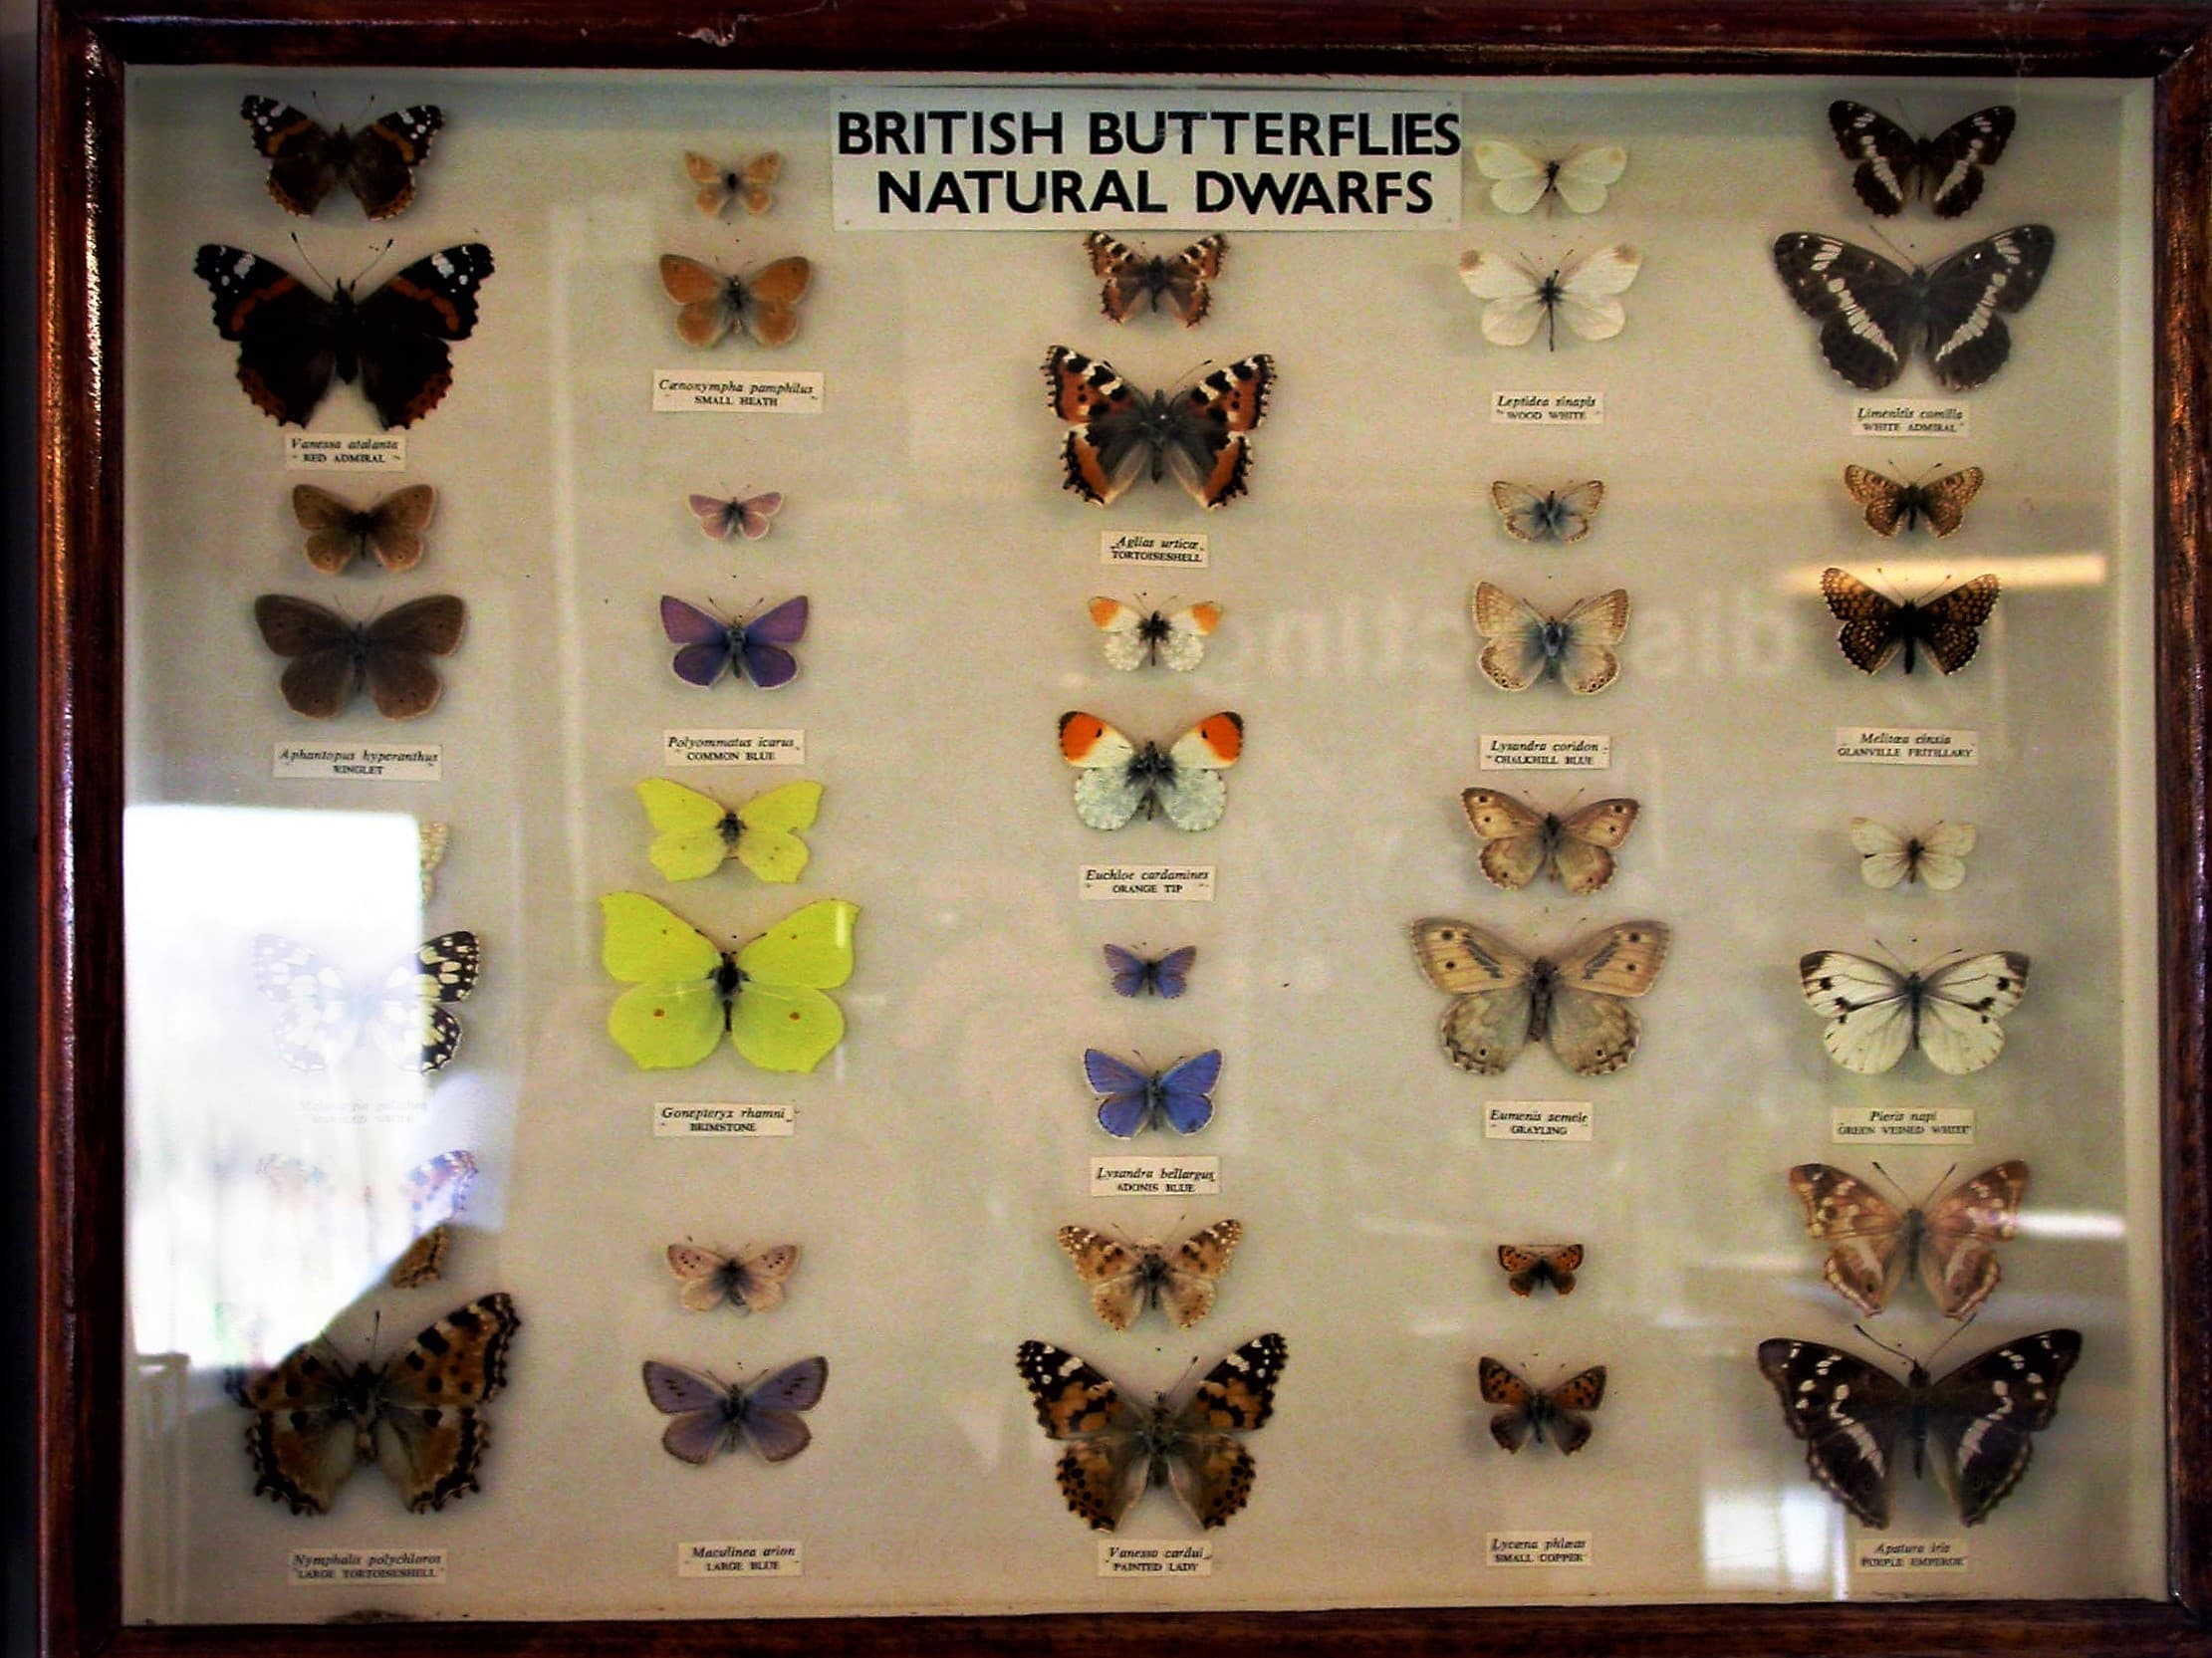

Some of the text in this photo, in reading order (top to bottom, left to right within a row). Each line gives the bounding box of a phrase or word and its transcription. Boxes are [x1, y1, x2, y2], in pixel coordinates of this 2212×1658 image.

[838, 111, 1462, 156] BRITISH BUTTERFLIES
[877, 169, 1434, 215] NATURAL DWARFS
[749, 381, 814, 397] pamphilus
[694, 396, 778, 406] SMALL HEATH
[1497, 395, 1597, 408] Leptidea sinapis
[1550, 411, 1586, 420] WHITE
[1857, 407, 1963, 419] Limenitis camilla
[1908, 423, 1957, 432] ADMIRAL
[291, 438, 398, 450] Vanessa atalanta
[303, 453, 385, 463] RED ADMIRAL
[1112, 550, 1203, 563] TORTOISESHELL
[668, 737, 795, 749] Polyommatus icarus
[1491, 740, 1598, 753] Lysandra coridon
[280, 748, 438, 764] Aphantopus hyperanthus
[687, 752, 775, 761] COMMON BLUE
[1837, 748, 1973, 758] GLANVILLE FRITILLARY
[1494, 755, 1593, 765] CHALKHILL BLUE
[333, 765, 384, 775] RINGLET
[1086, 869, 1209, 881] Euchloe cardamines
[1112, 884, 1183, 893] ORANGE TIP
[661, 1107, 786, 1121] Gonepteryx rhamni
[1490, 1109, 1588, 1123] Eumenis semele
[1869, 1110, 1937, 1123] Pieris napi
[689, 1122, 757, 1132] BRIMSTONE
[1511, 1125, 1568, 1135] GRAYLING
[1838, 1125, 1971, 1134] GREEN VEINED WHITE
[1097, 1167, 1215, 1182] Lysandra bellargus
[1116, 1183, 1195, 1193] ADONIS BLUE
[692, 1546, 796, 1557] Maculinea arion
[1108, 1546, 1204, 1558] Vanessa cardui
[1874, 1543, 1952, 1555] Apatura iris
[294, 1554, 441, 1567] Nymphalis polychloros
[1495, 1553, 1584, 1562] SMALL COPPER
[1861, 1557, 1963, 1567] PURPLE EMPEROR
[706, 1561, 780, 1571] LARGE BLUE
[1112, 1562, 1199, 1571] PAINTED LADY
[298, 1568, 436, 1579] LARGE TORTOISESHELL
